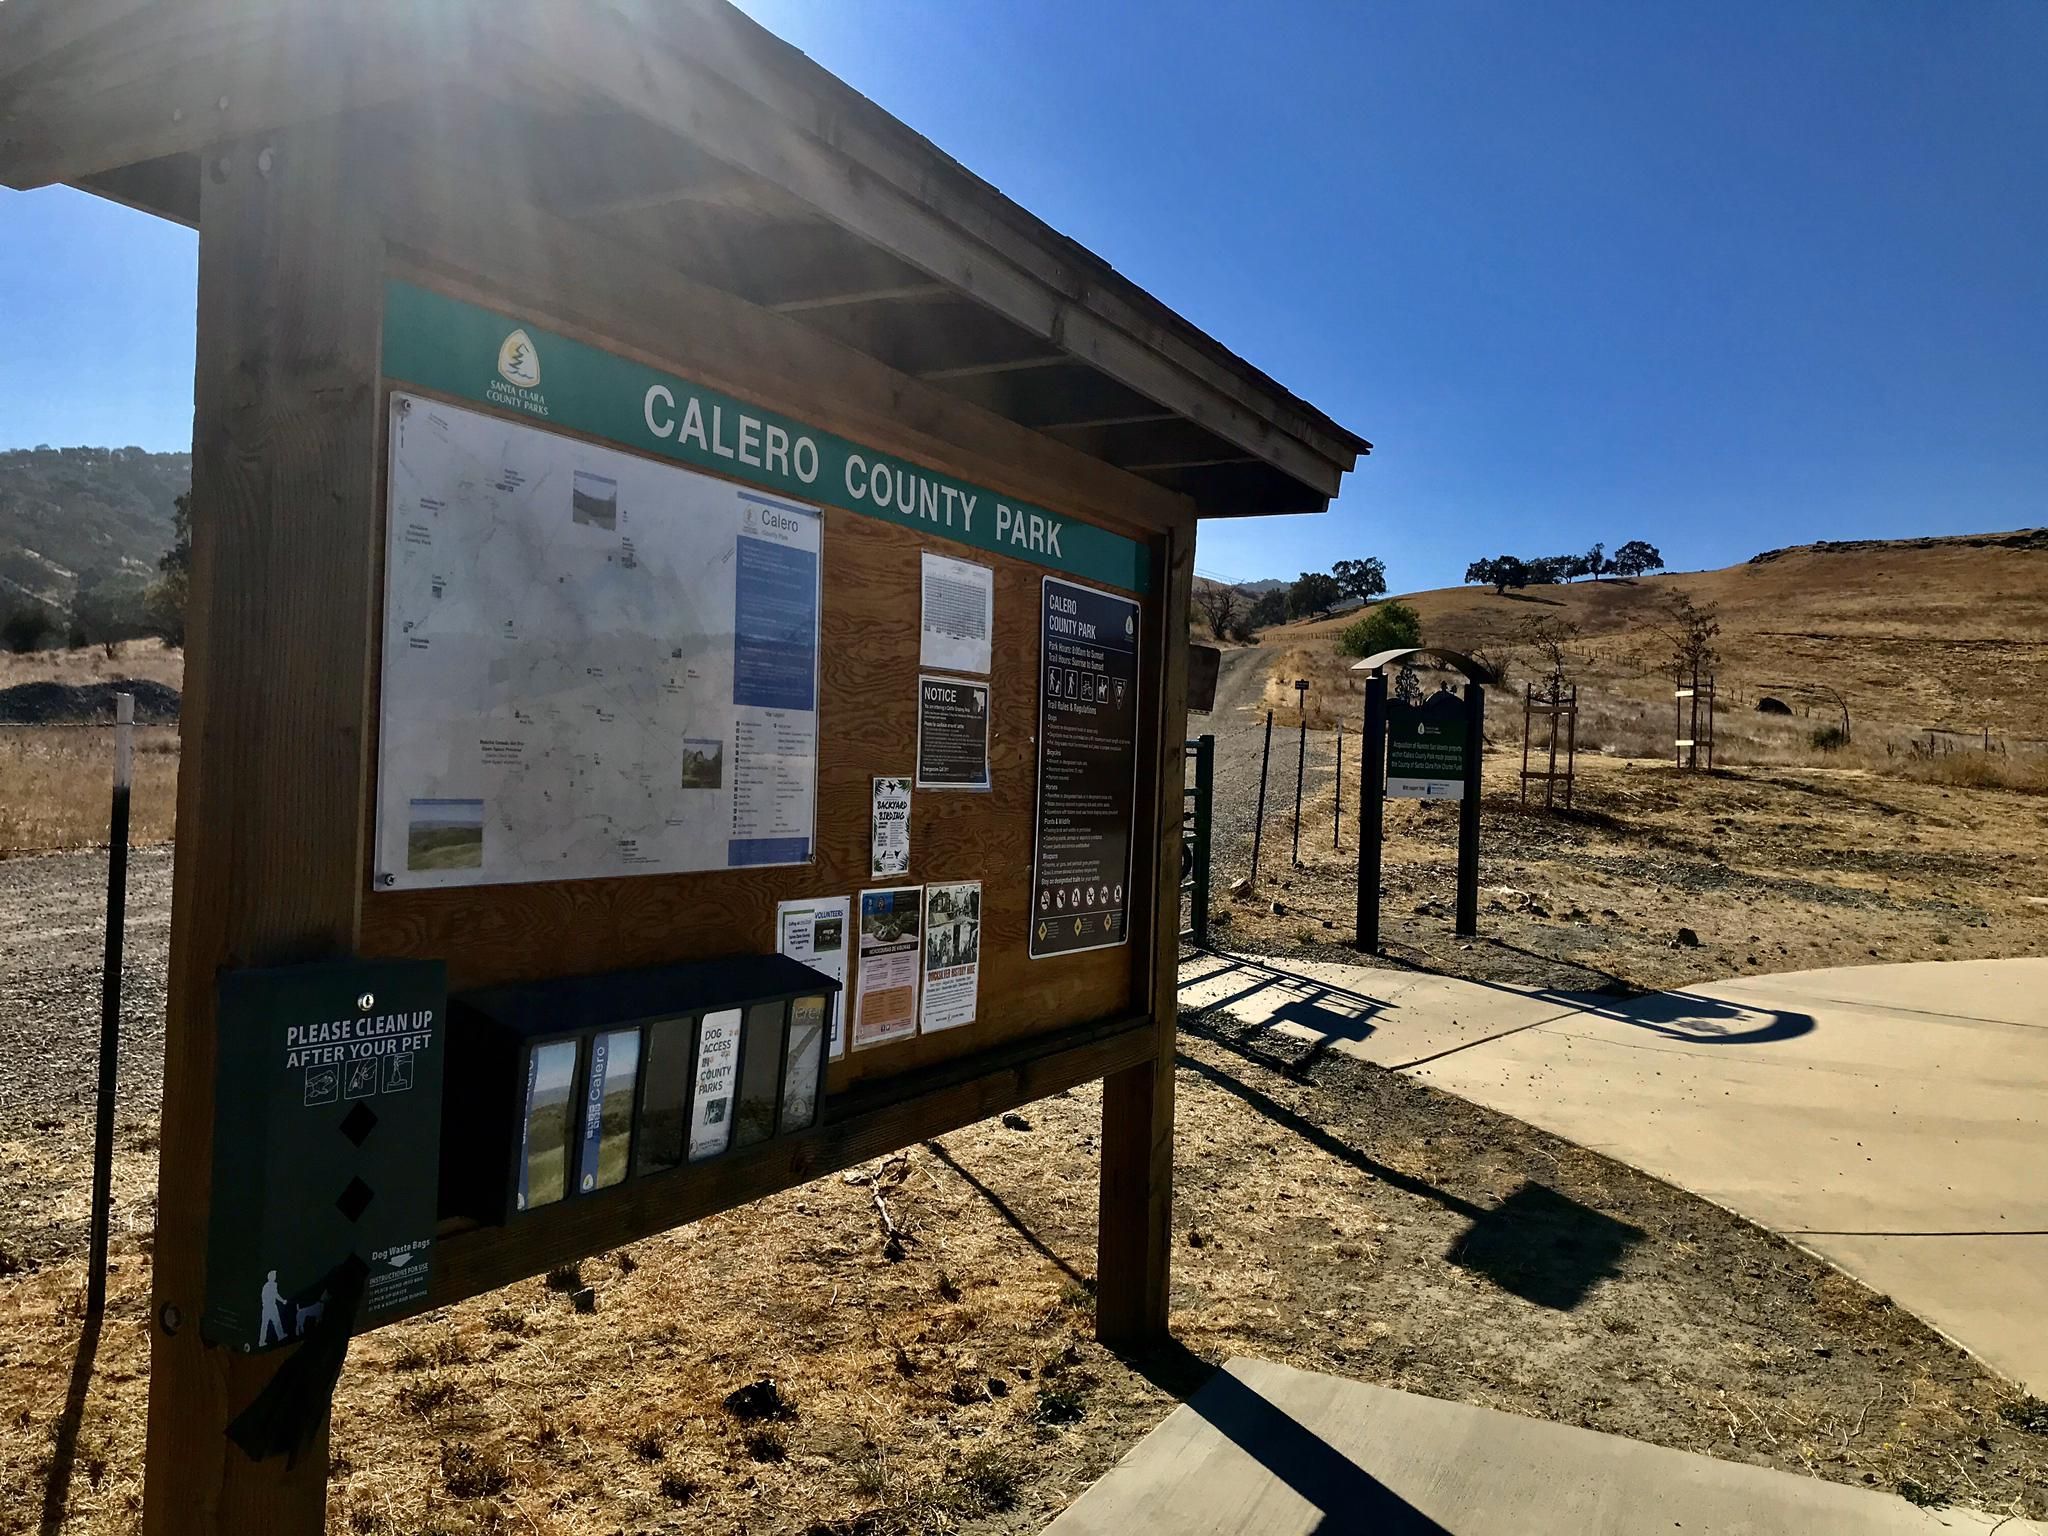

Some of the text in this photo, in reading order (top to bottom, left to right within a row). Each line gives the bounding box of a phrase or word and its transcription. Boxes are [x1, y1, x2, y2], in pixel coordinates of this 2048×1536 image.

[490, 380, 545, 404] SANTA CLARA
[486, 389, 549, 416] COUNTY PARKS
[644, 384, 1063, 559] CALERO COUNTY PARK
[762, 510, 799, 533] Calero
[1049, 595, 1077, 615] CALERO
[1049, 615, 1096, 640] COUNTY PARK
[1048, 641, 1058, 651] Park
[1048, 652, 1058, 662] Trail
[924, 687, 957, 703] NOTICE
[1048, 699, 1058, 710] Trail
[1074, 704, 1097, 716] Regulations
[877, 801, 908, 810] BACKYARD
[879, 811, 905, 820] BIRDING
[815, 909, 843, 920] VOLUNTEERS
[287, 1010, 433, 1047] PLEASE CLEAN UP
[705, 1028, 722, 1041] DOG
[286, 1034, 432, 1069] AFTER YOUR PET
[703, 1039, 731, 1055] ACCESS
[701, 1057, 710, 1068] IN
[590, 1046, 606, 1102] Calero
[700, 1065, 731, 1081] COUNTY
[698, 1080, 723, 1095] PARKS
[372, 1239, 431, 1261] Dog Waste Bags
[369, 1262, 429, 1285] INSTRUCTIONS FOR USE
